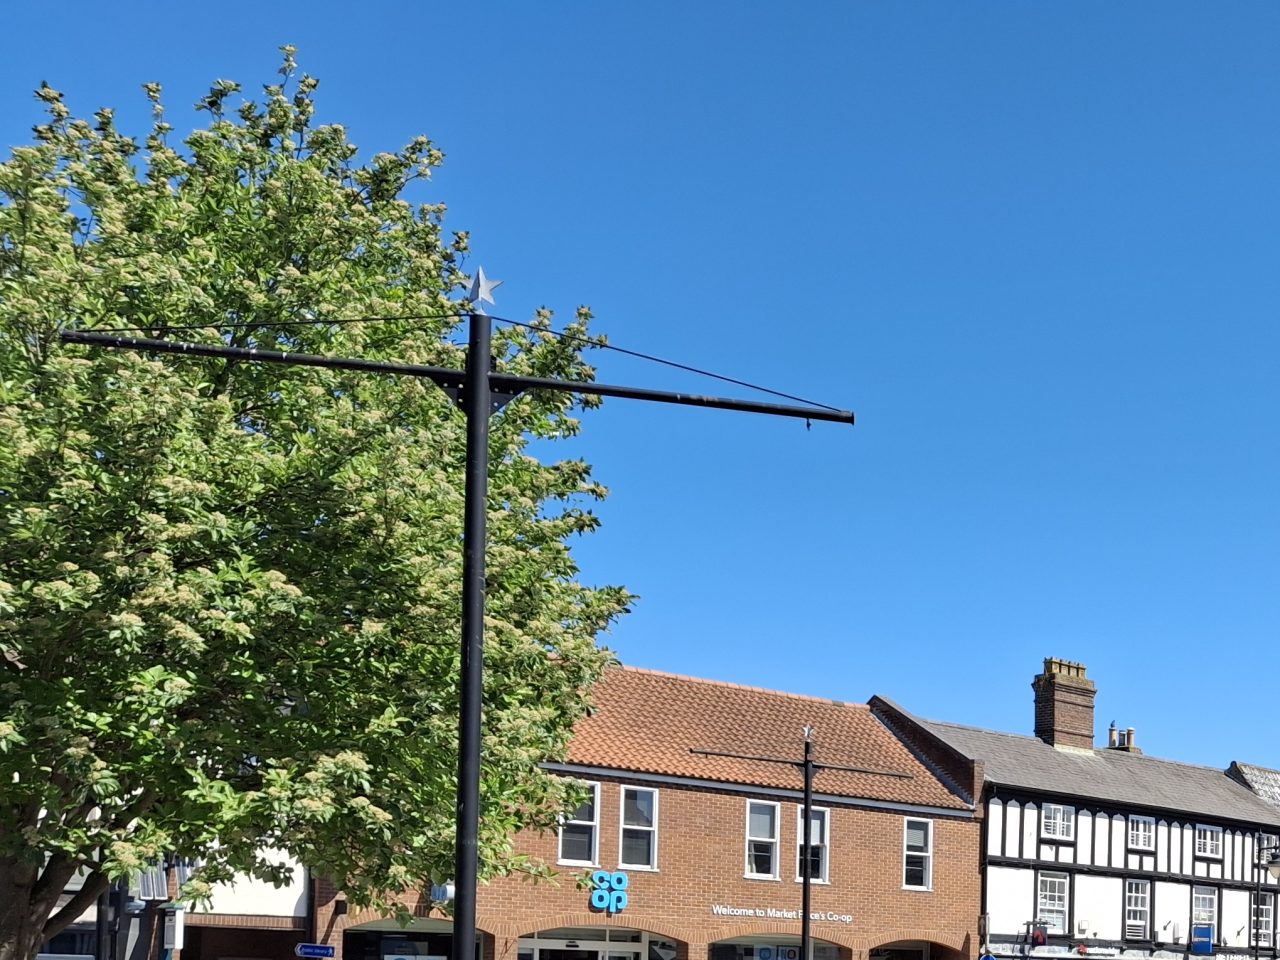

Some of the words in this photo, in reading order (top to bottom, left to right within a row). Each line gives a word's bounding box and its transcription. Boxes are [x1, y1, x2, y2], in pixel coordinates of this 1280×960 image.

[712, 904, 754, 917] Welcome
[755, 907, 765, 917] to
[766, 908, 797, 920] Market
[798, 910, 826, 921] Pce's
[826, 911, 853, 924] Co-op
